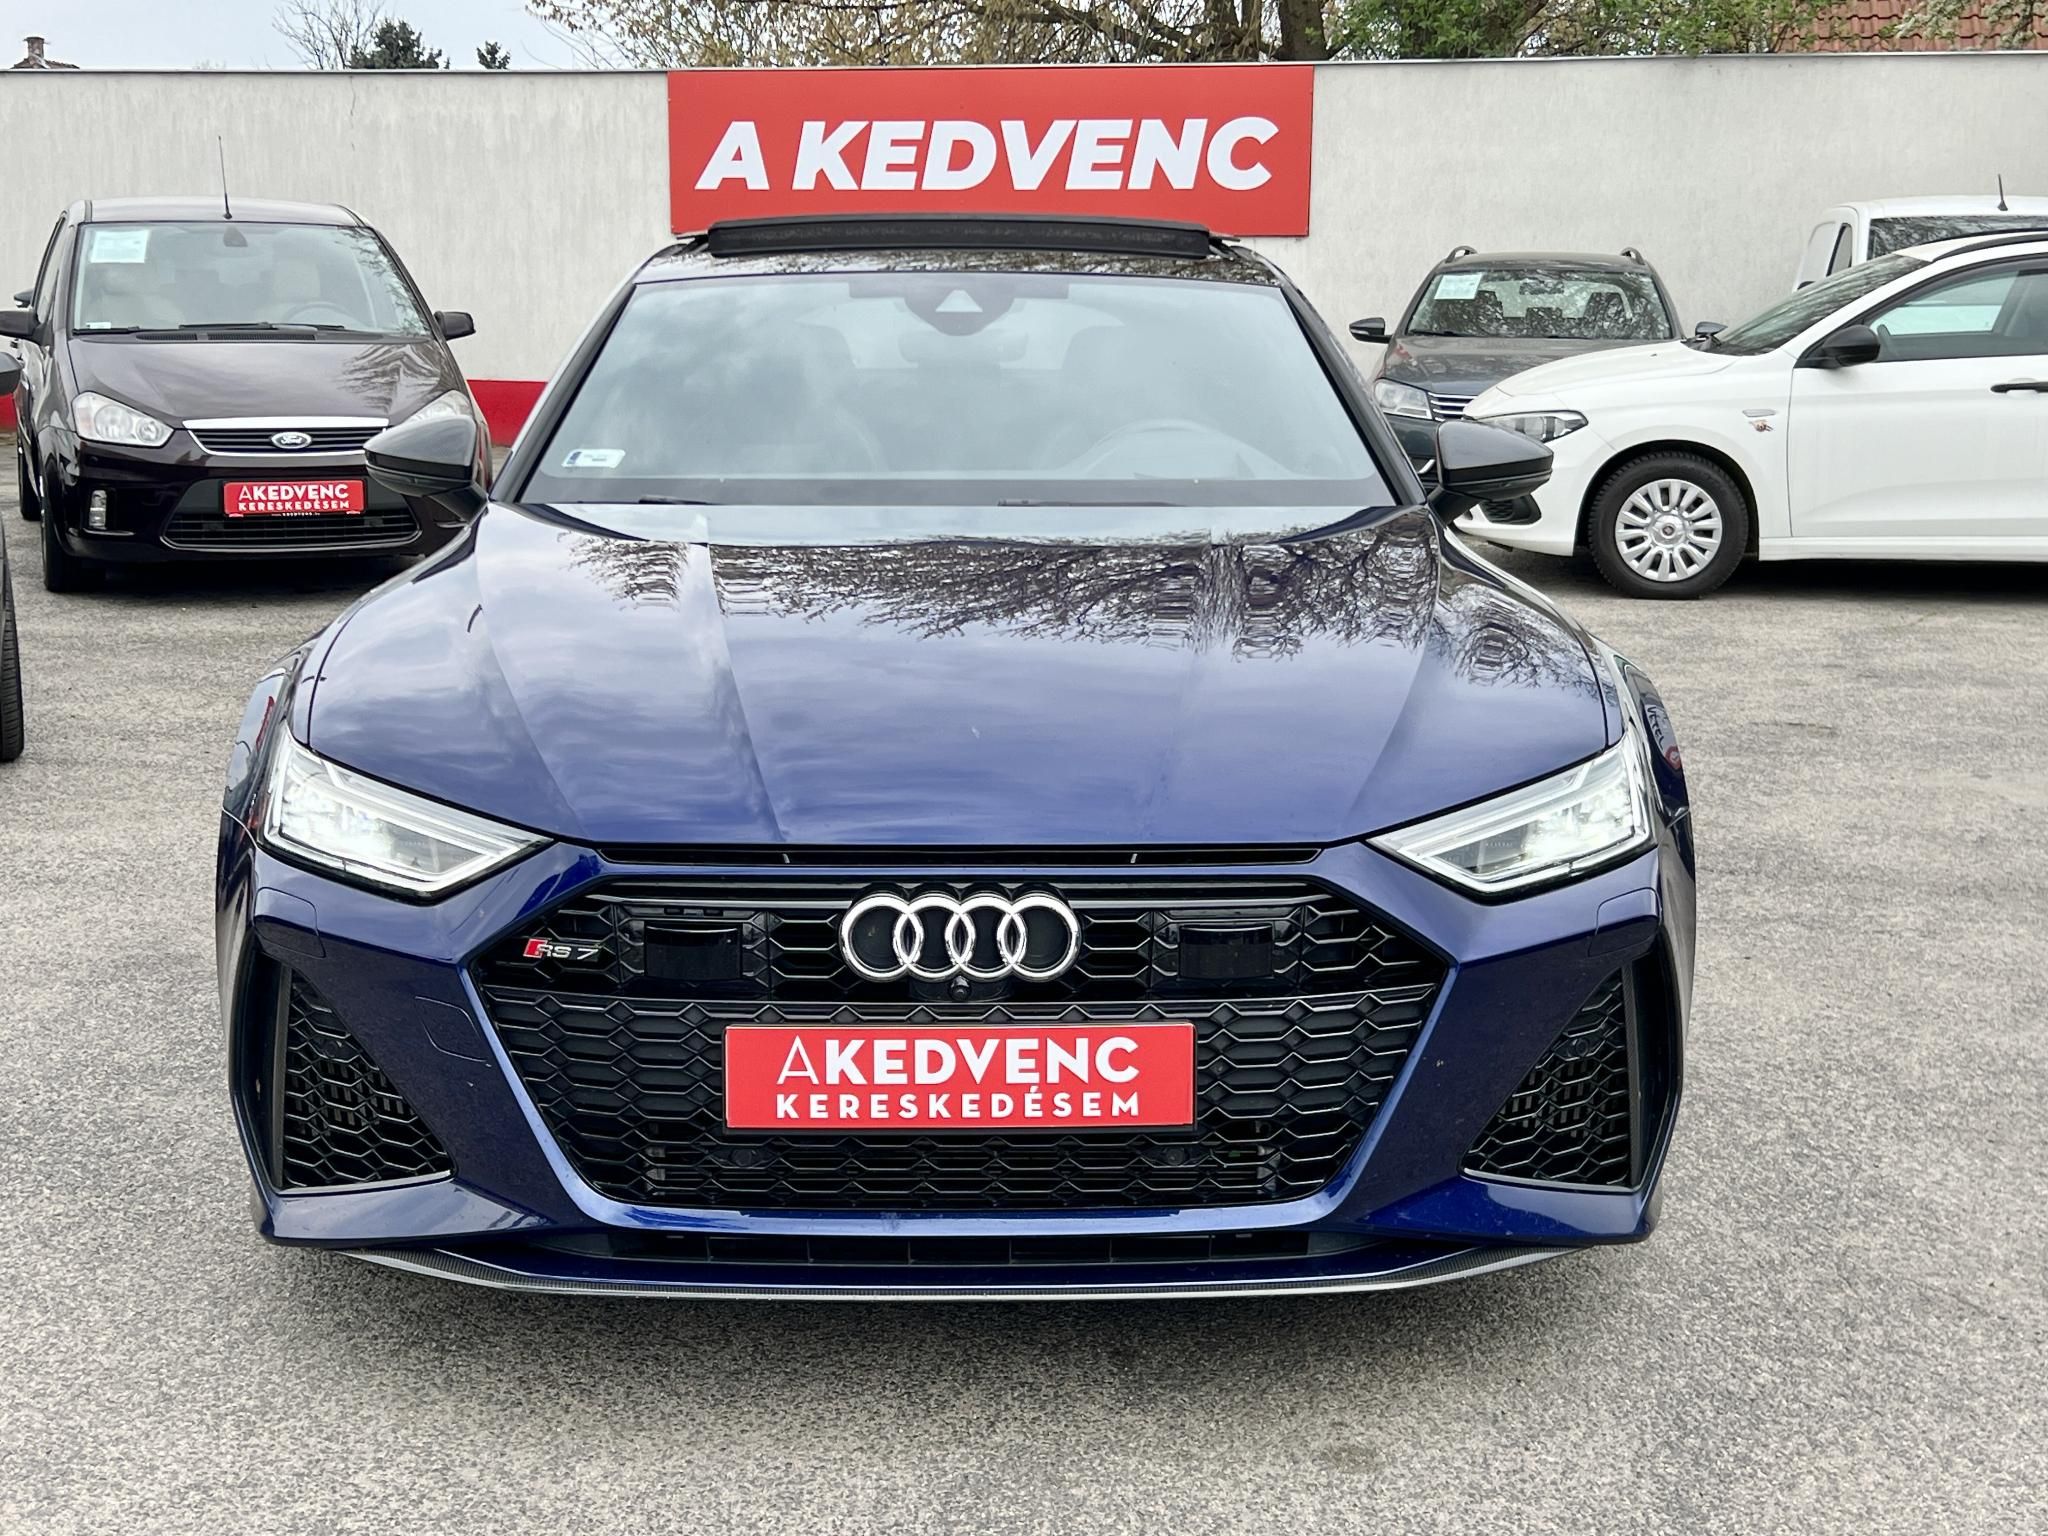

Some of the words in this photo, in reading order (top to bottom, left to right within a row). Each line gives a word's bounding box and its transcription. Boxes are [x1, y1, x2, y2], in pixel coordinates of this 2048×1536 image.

[694, 120, 770, 190] A
[792, 116, 1280, 190] KEDVENC
[238, 499, 350, 511] KERESKEDÉSEM
[776, 1086, 1140, 1120] KERESKEDÉSEM
